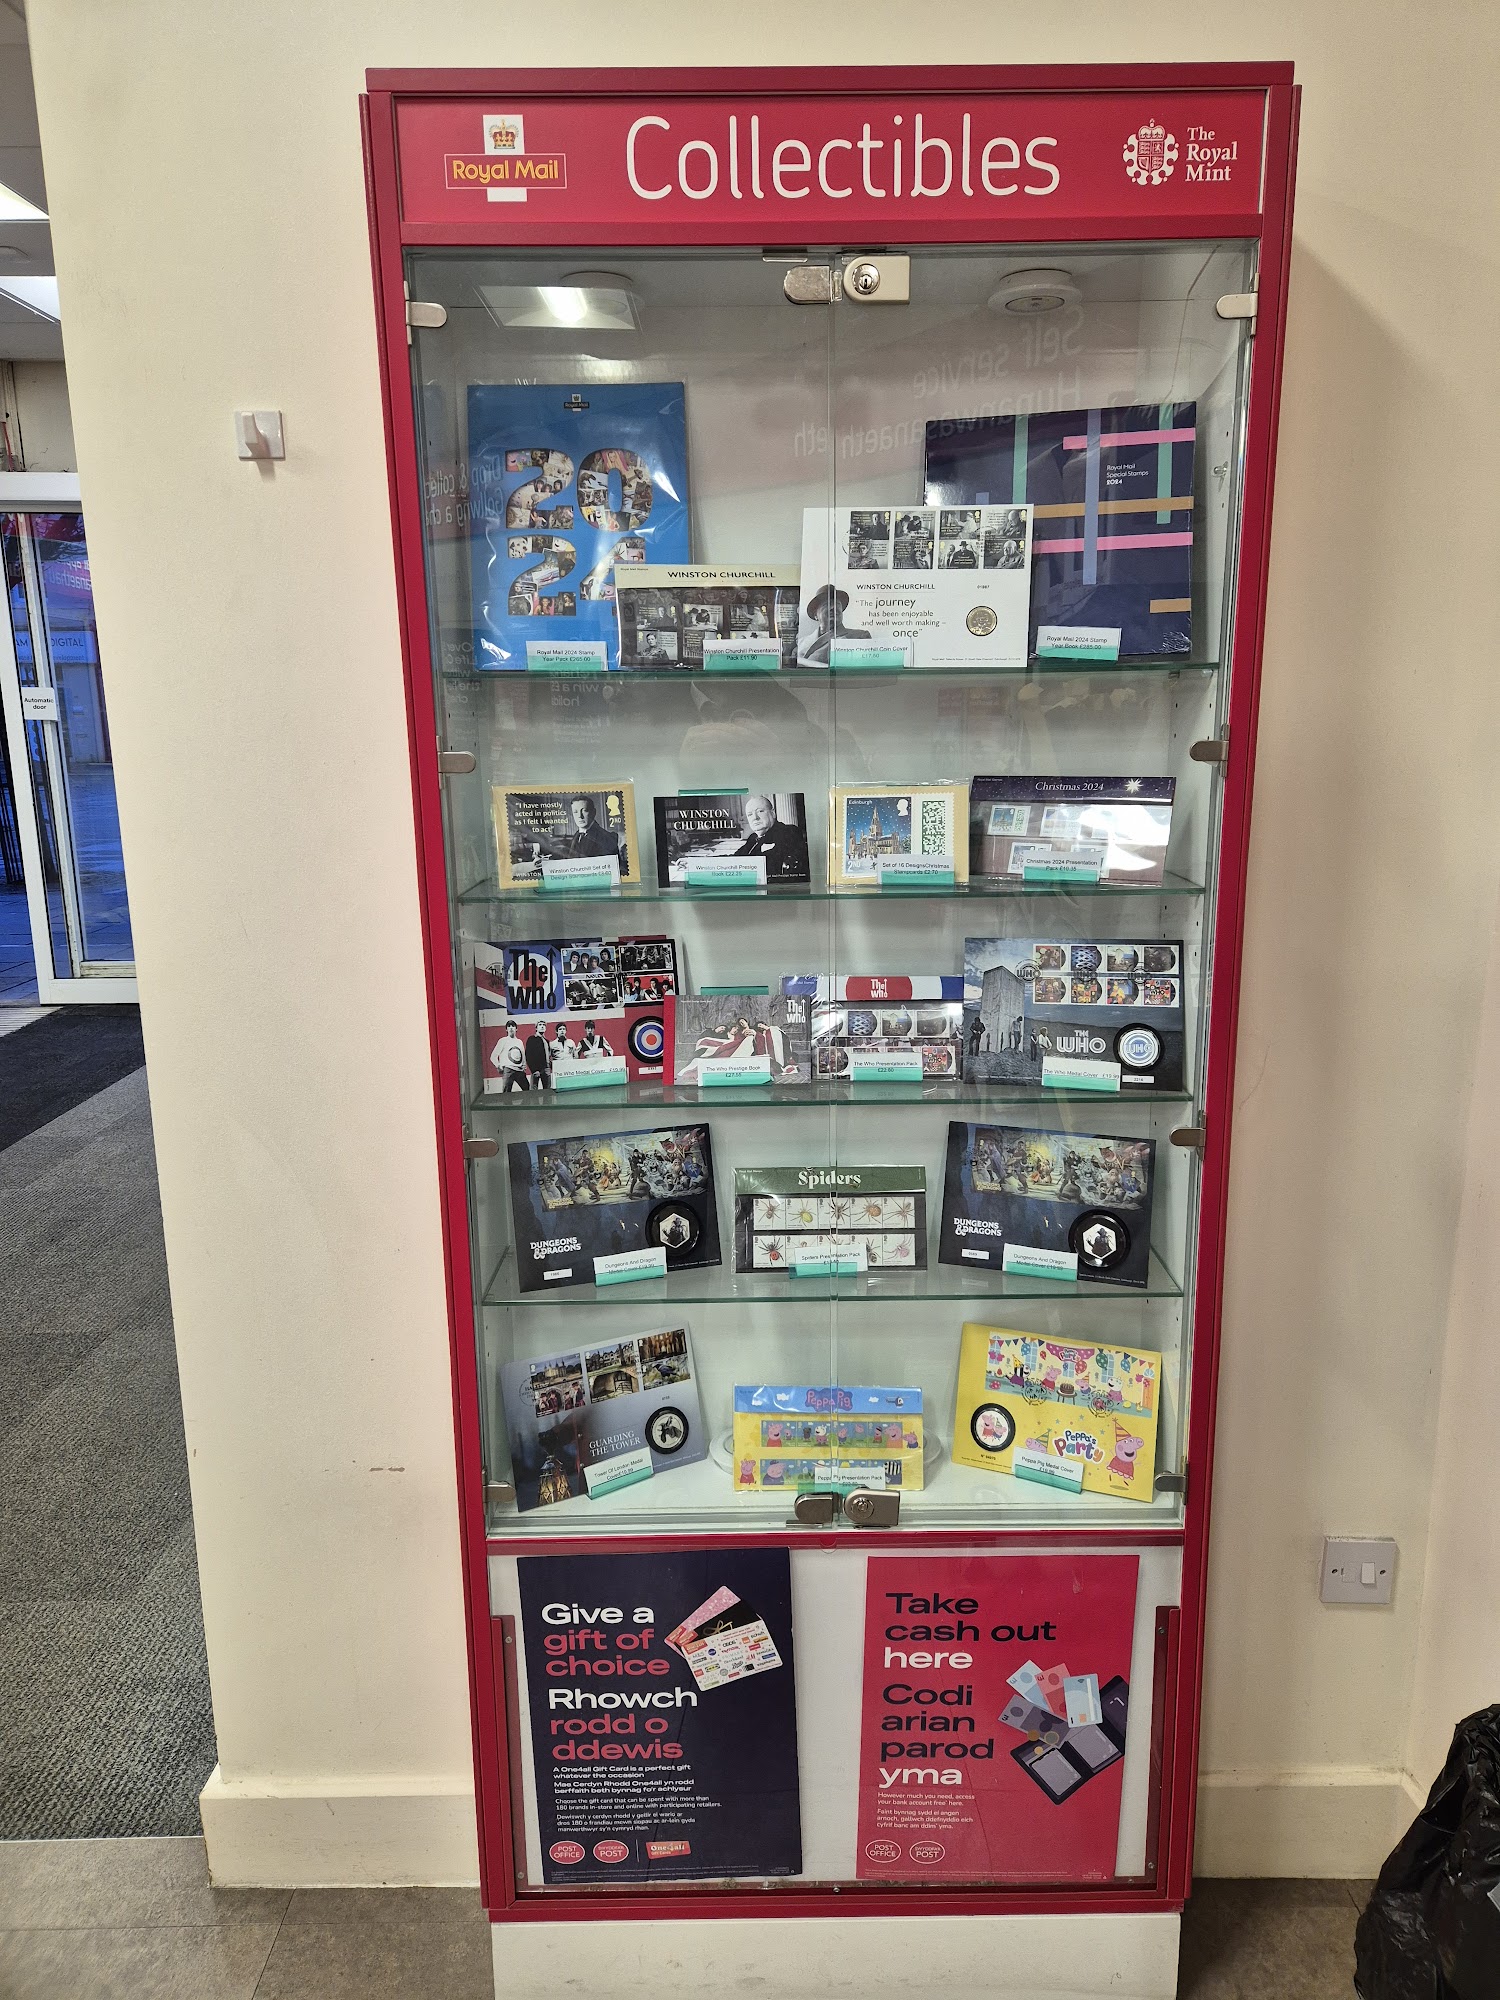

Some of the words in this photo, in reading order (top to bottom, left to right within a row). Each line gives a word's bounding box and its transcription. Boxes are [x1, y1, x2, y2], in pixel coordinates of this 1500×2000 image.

[1187, 126, 1215, 141] The
[626, 112, 1060, 200] Collectibles
[1186, 142, 1238, 166] Royal
[452, 158, 509, 184] Royal
[515, 158, 559, 180] Mail
[1185, 164, 1231, 181] Mint
[719, 571, 776, 579] CHURCHILL
[875, 597, 916, 609] journey
[901, 609, 934, 619] enjoyable
[915, 619, 940, 628] making
[1035, 781, 1081, 791] Christmas
[1082, 783, 1104, 791] 2024
[523, 801, 539, 809] have
[540, 801, 563, 810] mostly
[848, 799, 873, 807] Edinburgh
[543, 809, 567, 818] politics
[544, 817, 569, 825] wanted
[679, 808, 730, 819] WINSTON
[673, 819, 737, 830] CHURCHILL
[1056, 1036, 1106, 1054] WHO
[798, 1170, 862, 1190] Spiders
[954, 1217, 999, 1230] DUNGEONS
[530, 1236, 578, 1250] DUNGEONS
[589, 1430, 635, 1449] GUARDING
[590, 1445, 609, 1457] THE
[610, 1436, 641, 1451] TOWER
[1065, 1430, 1097, 1445] Peppa's
[1054, 1438, 1104, 1463] Party
[885, 1592, 979, 1615] Take
[541, 1602, 624, 1625] Give
[632, 1606, 655, 1625] a
[884, 1620, 980, 1642] cash
[990, 1621, 1057, 1642] out
[543, 1629, 607, 1656] gift
[615, 1628, 654, 1650] of
[545, 1653, 671, 1677] choice
[884, 1647, 973, 1669] here
[548, 1686, 699, 1710] Rhowch
[882, 1683, 973, 1706] Codi
[550, 1713, 636, 1735] rodd
[644, 1717, 669, 1734] o
[881, 1710, 976, 1732] arian
[551, 1738, 684, 1761] ddewis
[880, 1738, 995, 1762] parod
[644, 1765, 676, 1773] perfect
[676, 1764, 692, 1772] gift
[878, 1767, 963, 1789] yma
